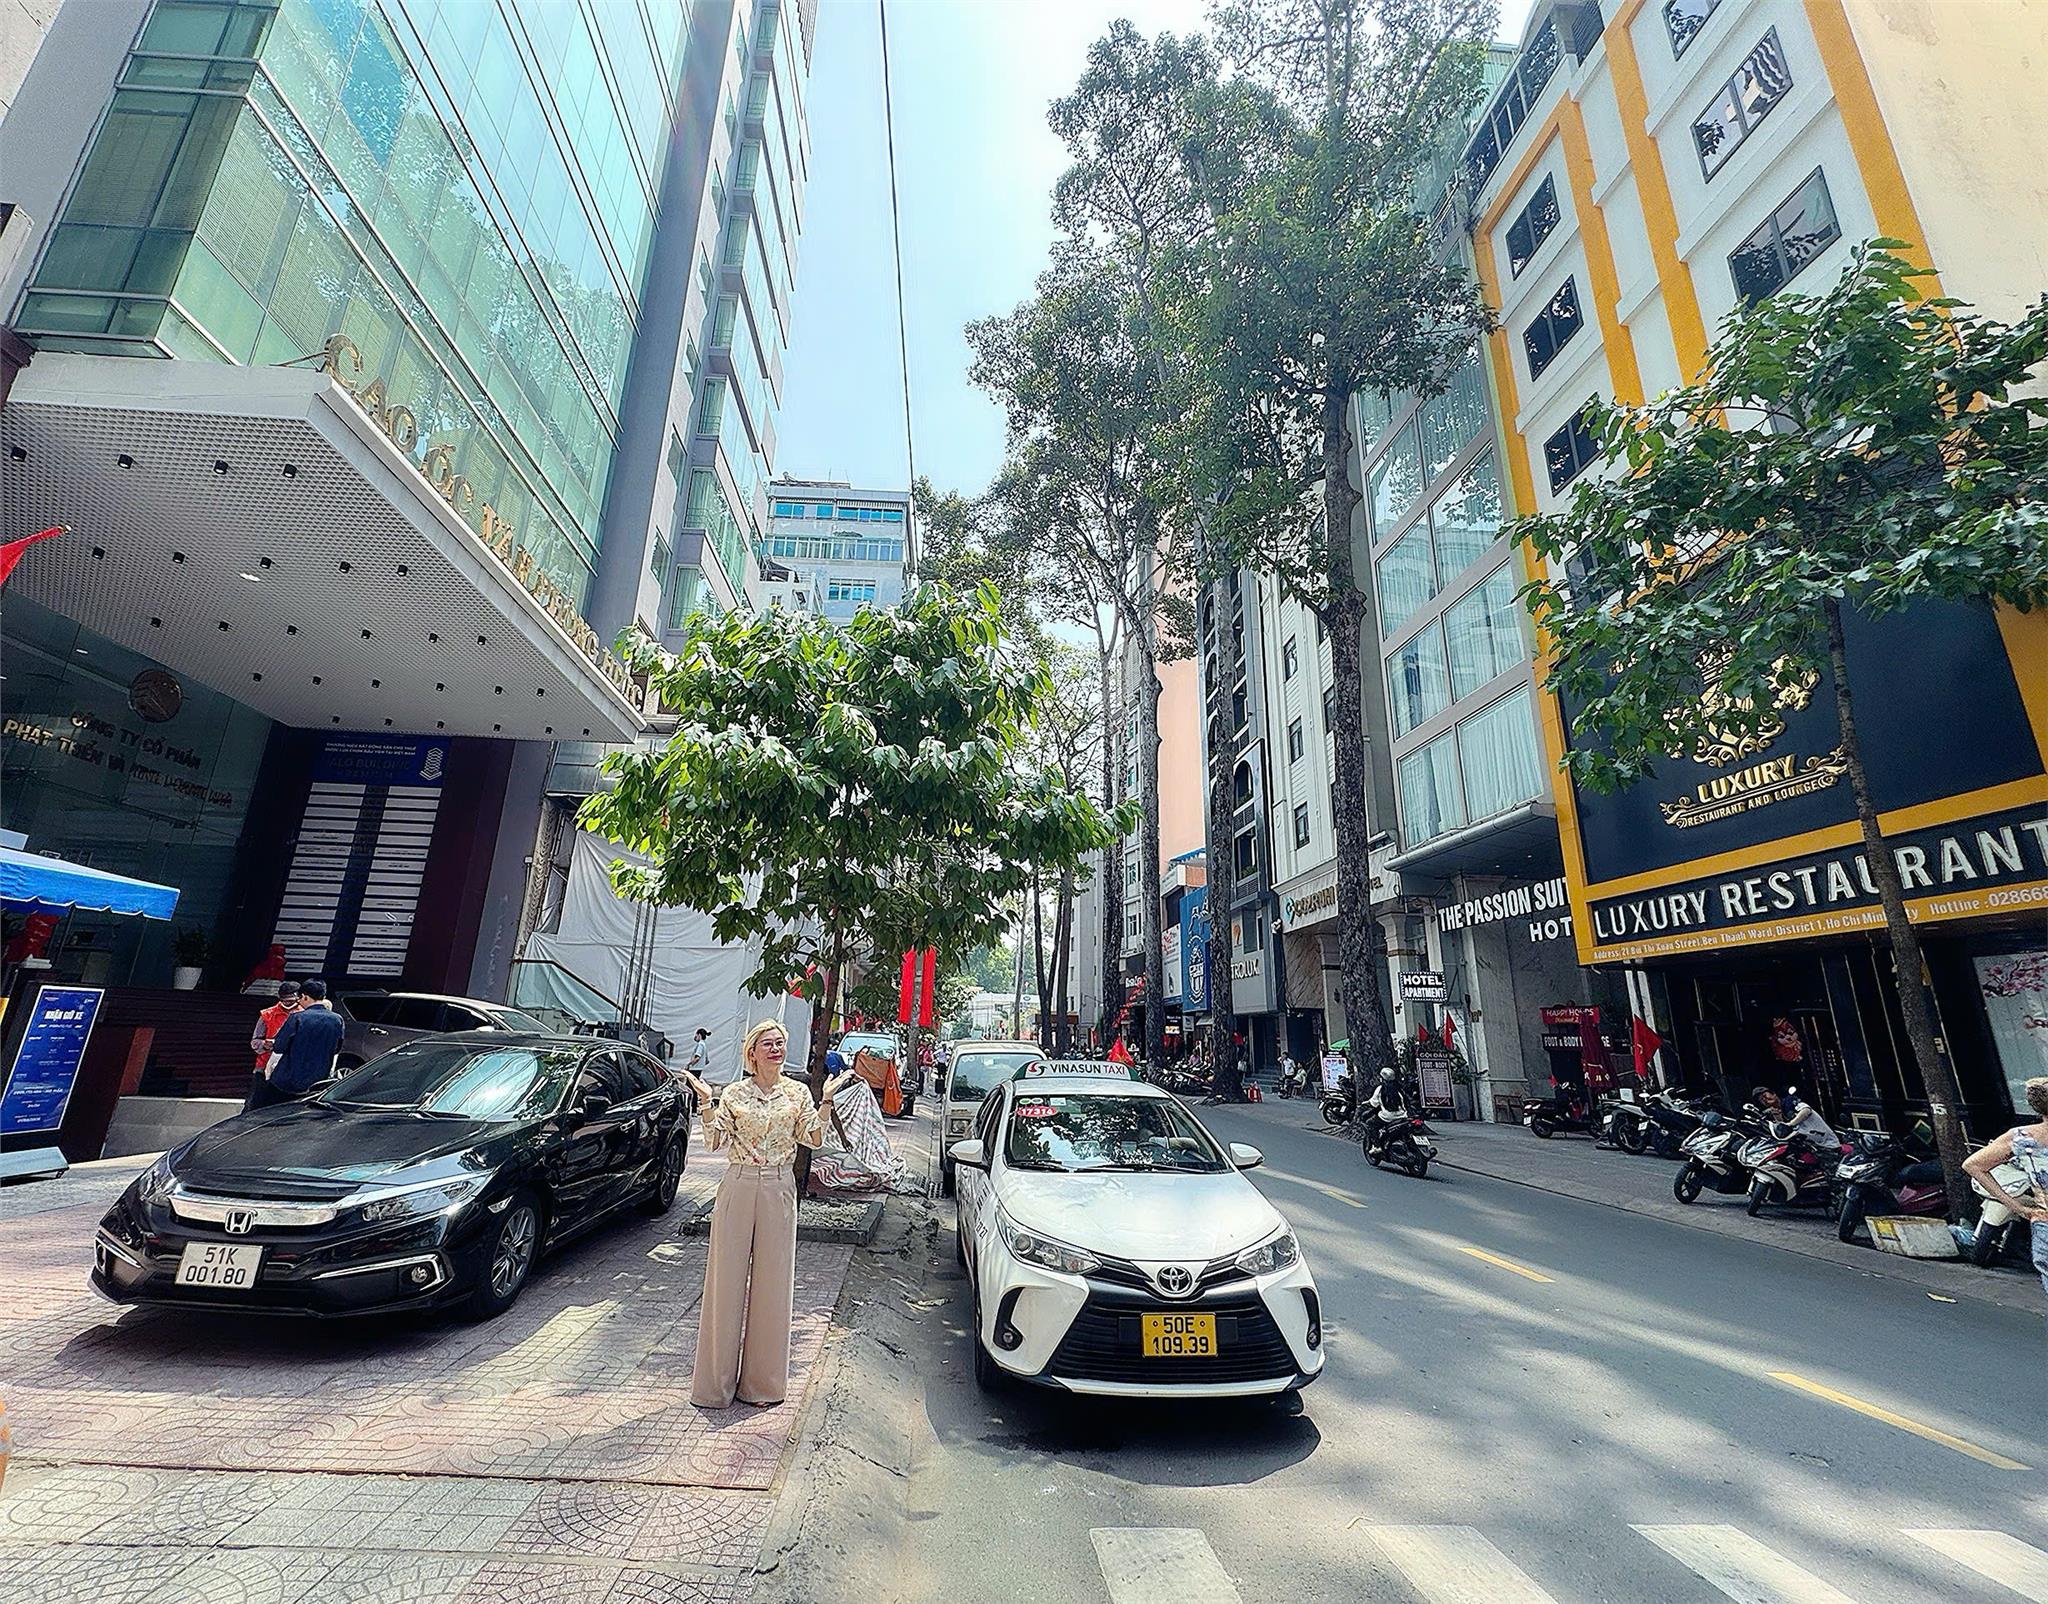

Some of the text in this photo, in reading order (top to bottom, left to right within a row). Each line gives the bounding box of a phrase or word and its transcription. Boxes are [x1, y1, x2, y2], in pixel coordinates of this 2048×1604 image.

[325, 334, 417, 453] CAO
[3, 719, 54, 746] PHÁT
[1696, 753, 1797, 803] LUXURY
[1687, 780, 1820, 827] RESTAURANT AND LOUNGE
[1594, 818, 2048, 938] LUXURY RESTAURANT
[1438, 877, 1571, 932] THE PASSION SUIT
[1842, 915, 1860, 927] Chi
[1929, 898, 1979, 915] Hotline
[1529, 916, 1572, 942] HOT
[1403, 975, 1442, 985] HOTEL
[1404, 987, 1444, 998] APARTMENT
[1546, 1008, 1568, 1016] HAPPY
[1544, 1036, 1558, 1047] FOOT
[1564, 1036, 1578, 1047] BODY
[1050, 1063, 1126, 1075] VINASUN TAXI
[204, 1246, 239, 1265] 51K
[185, 1265, 247, 1285] 001.80
[1163, 1316, 1195, 1333] 50E
[1152, 1336, 1209, 1354] 109.39
